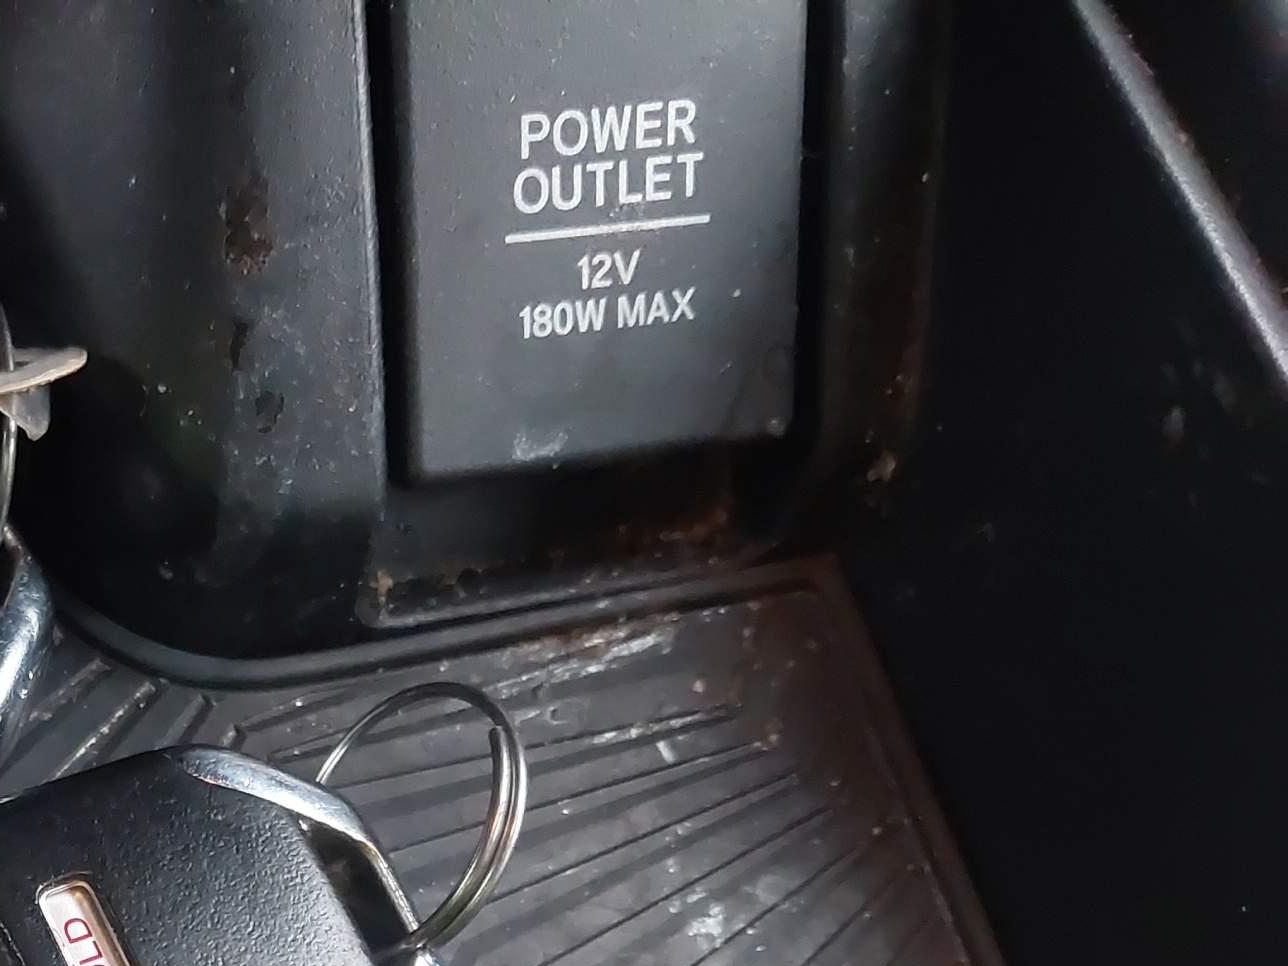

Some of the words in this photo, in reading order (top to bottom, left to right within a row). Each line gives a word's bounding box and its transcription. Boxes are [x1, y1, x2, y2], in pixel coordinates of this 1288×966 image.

[520, 99, 696, 160] POWER
[513, 152, 704, 214] OUTLET
[576, 249, 641, 290] 12V
[519, 296, 608, 339] 180W
[617, 286, 696, 329] MAX
